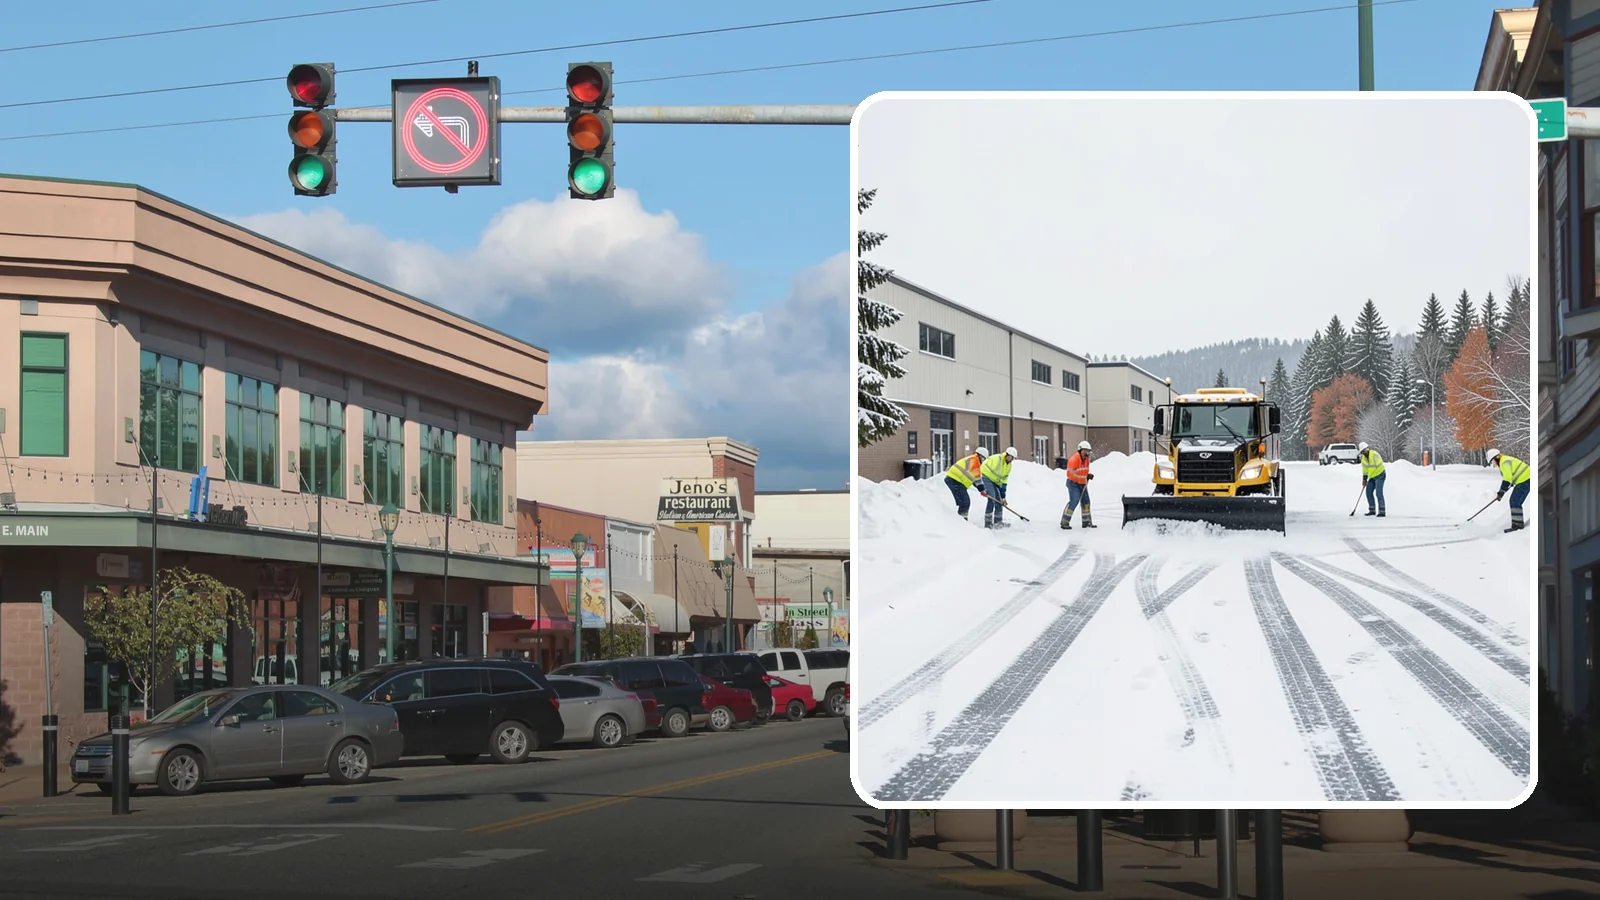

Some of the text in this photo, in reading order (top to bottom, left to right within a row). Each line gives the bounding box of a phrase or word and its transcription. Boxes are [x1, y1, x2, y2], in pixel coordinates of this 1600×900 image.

[670, 480, 727, 494] Jeno's
[665, 496, 731, 509] restaurant
[658, 510, 681, 519] Italian
[686, 510, 714, 519] American
[715, 509, 737, 519] Cuisine
[2, 525, 49, 536] E. MAIN
[797, 607, 828, 616] Street
